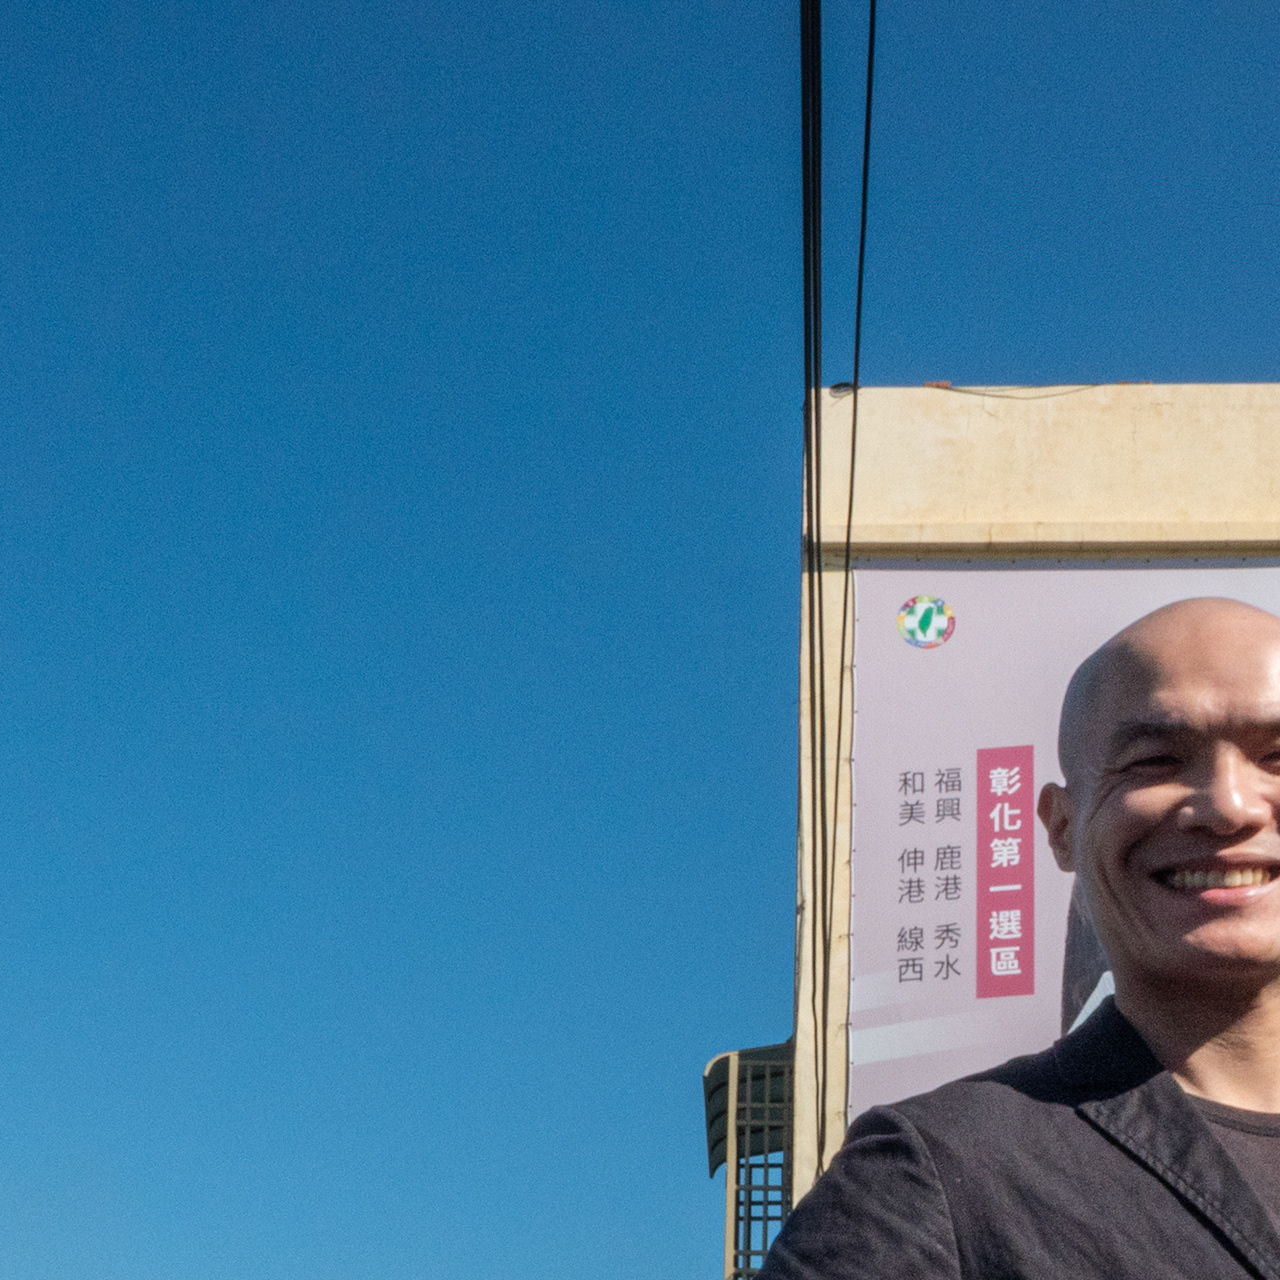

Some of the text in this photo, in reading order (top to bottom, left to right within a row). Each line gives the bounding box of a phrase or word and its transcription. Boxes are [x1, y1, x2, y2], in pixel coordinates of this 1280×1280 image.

[897, 771, 925, 983] 和美 伸港 線西
[934, 767, 962, 981] 福興 鹿港 秀水
[989, 766, 1022, 976] 彰化第一選區
